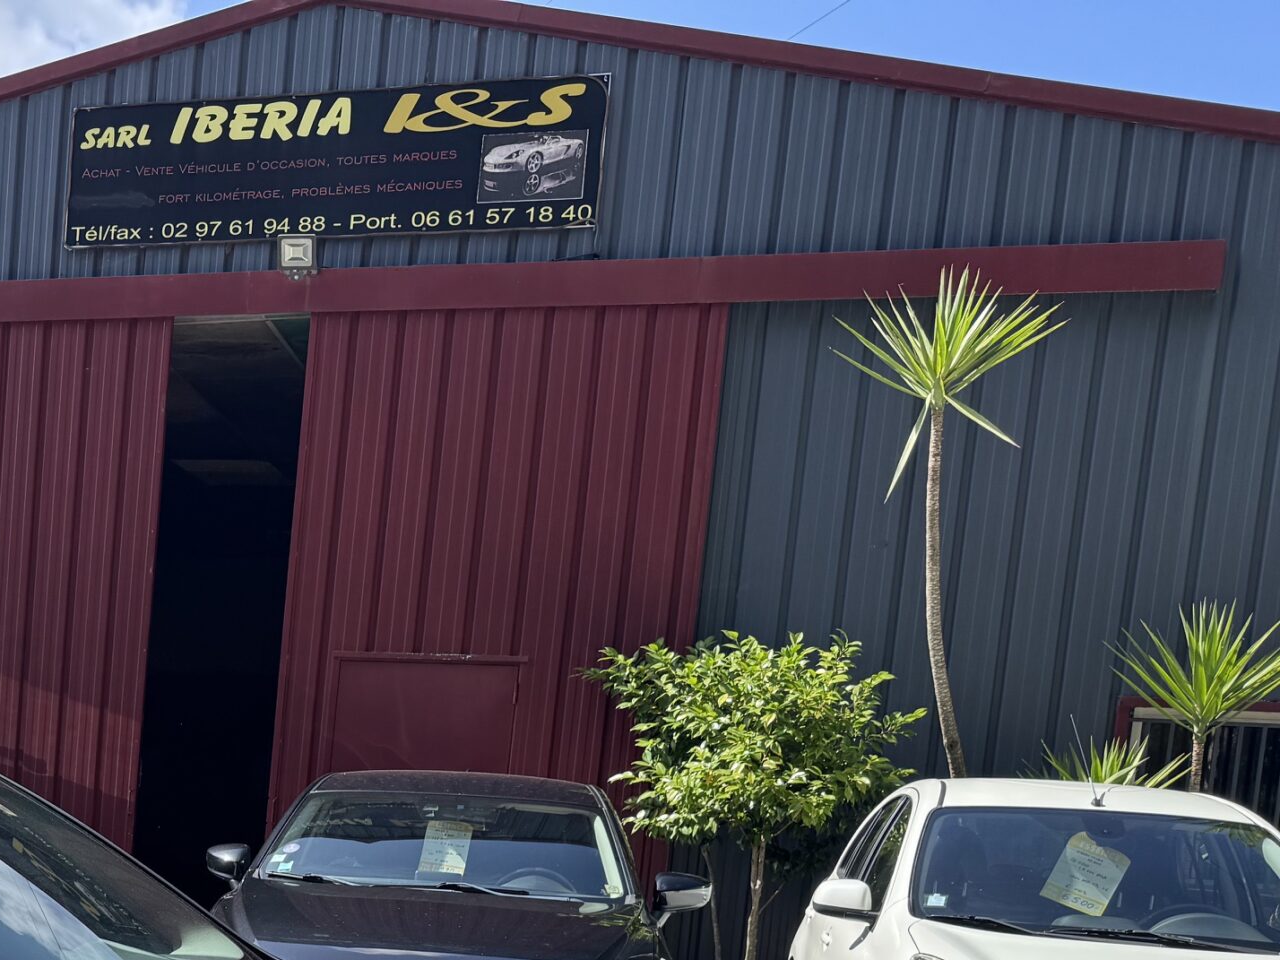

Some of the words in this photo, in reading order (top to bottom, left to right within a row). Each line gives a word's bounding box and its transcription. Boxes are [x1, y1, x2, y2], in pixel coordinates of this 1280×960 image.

[80, 124, 152, 150] SARL
[170, 97, 352, 145] IBERIA
[383, 83, 587, 133] I&S
[81, 167, 122, 180] ACHAT
[135, 165, 174, 177] VENTE
[179, 161, 241, 175] VÉHICULE
[336, 153, 388, 166] TOUTES
[393, 150, 458, 164] MARQUES
[158, 193, 193, 205] FORT
[291, 181, 371, 198] PROBLÈMES
[376, 179, 463, 194] MÉCANIQUES
[71, 224, 142, 242] Tél/fax
[161, 223, 188, 239] 02
[195, 220, 222, 238] 97
[229, 219, 254, 236] 61
[263, 218, 290, 234] 94
[298, 216, 326, 232] 88
[349, 213, 402, 230] Port.
[411, 211, 440, 227] 06
[448, 209, 475, 226] 61
[485, 207, 516, 224] 57
[526, 206, 553, 222] 18
[561, 205, 592, 222] 40
